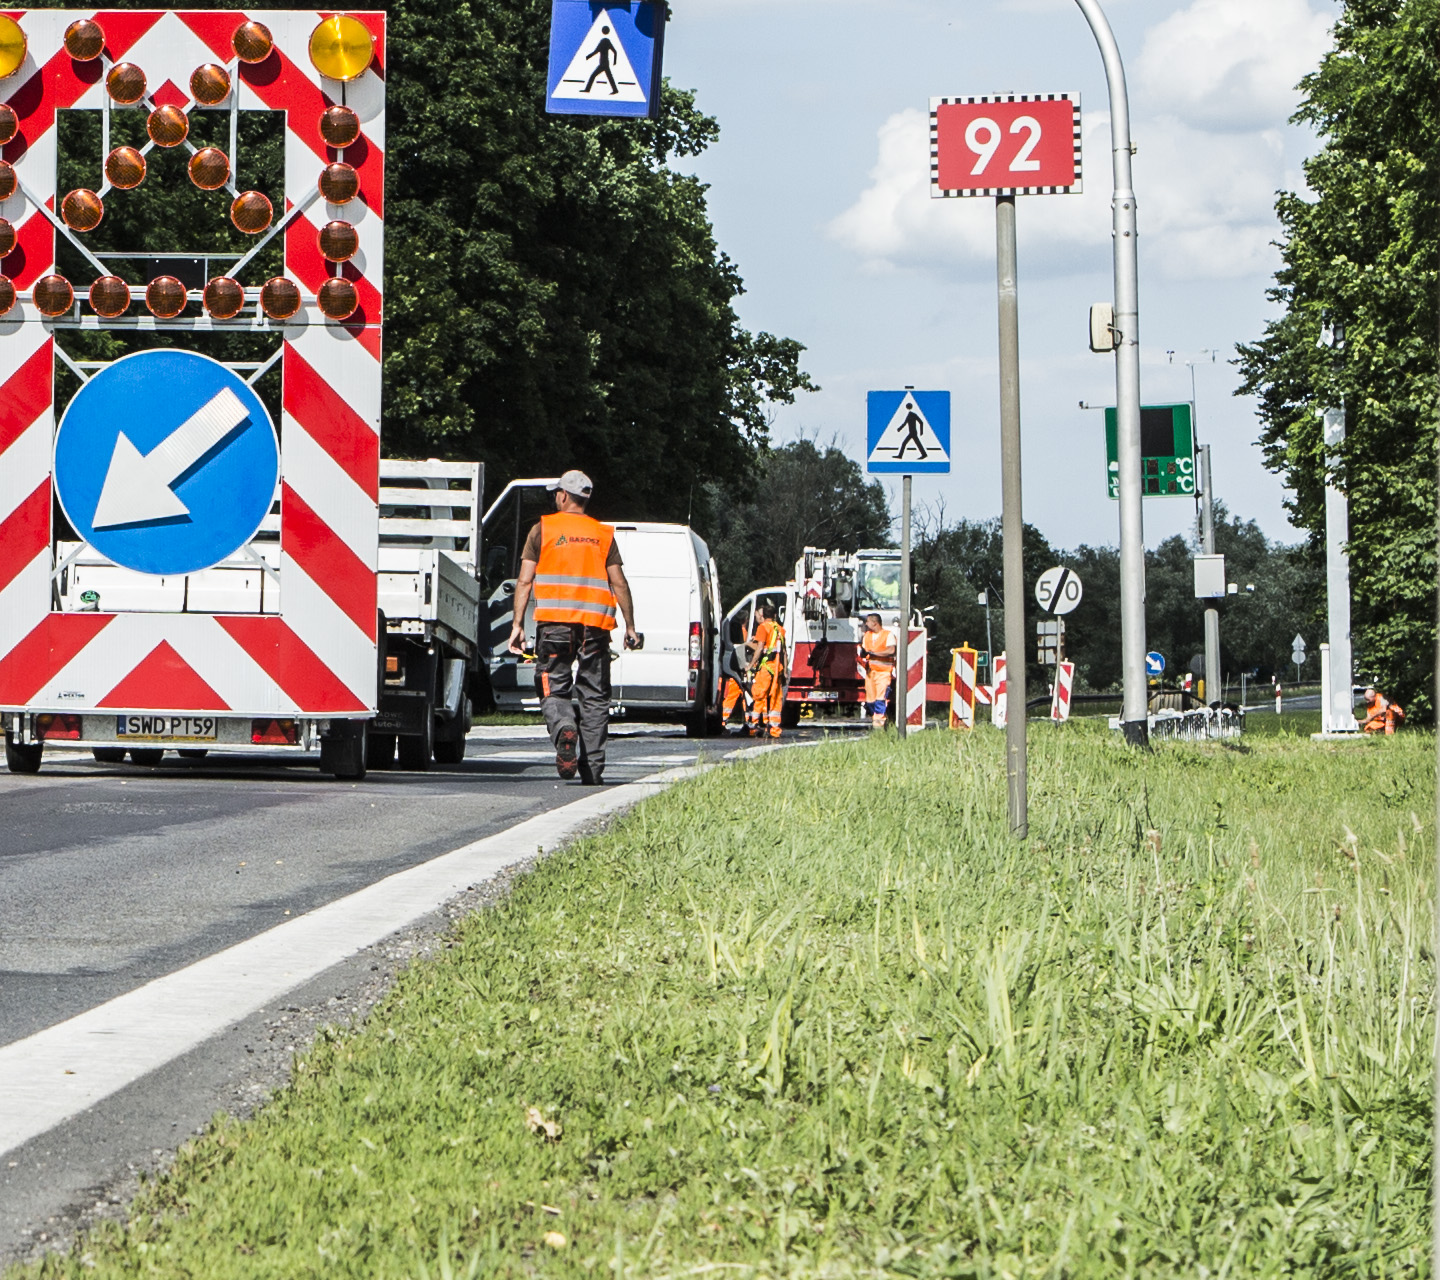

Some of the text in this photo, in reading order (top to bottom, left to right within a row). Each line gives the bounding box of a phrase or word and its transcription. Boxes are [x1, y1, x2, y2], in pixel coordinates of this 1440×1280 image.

[964, 115, 1042, 176] 92
[1039, 580, 1080, 602] 50
[128, 716, 214, 735] SWD PT59
